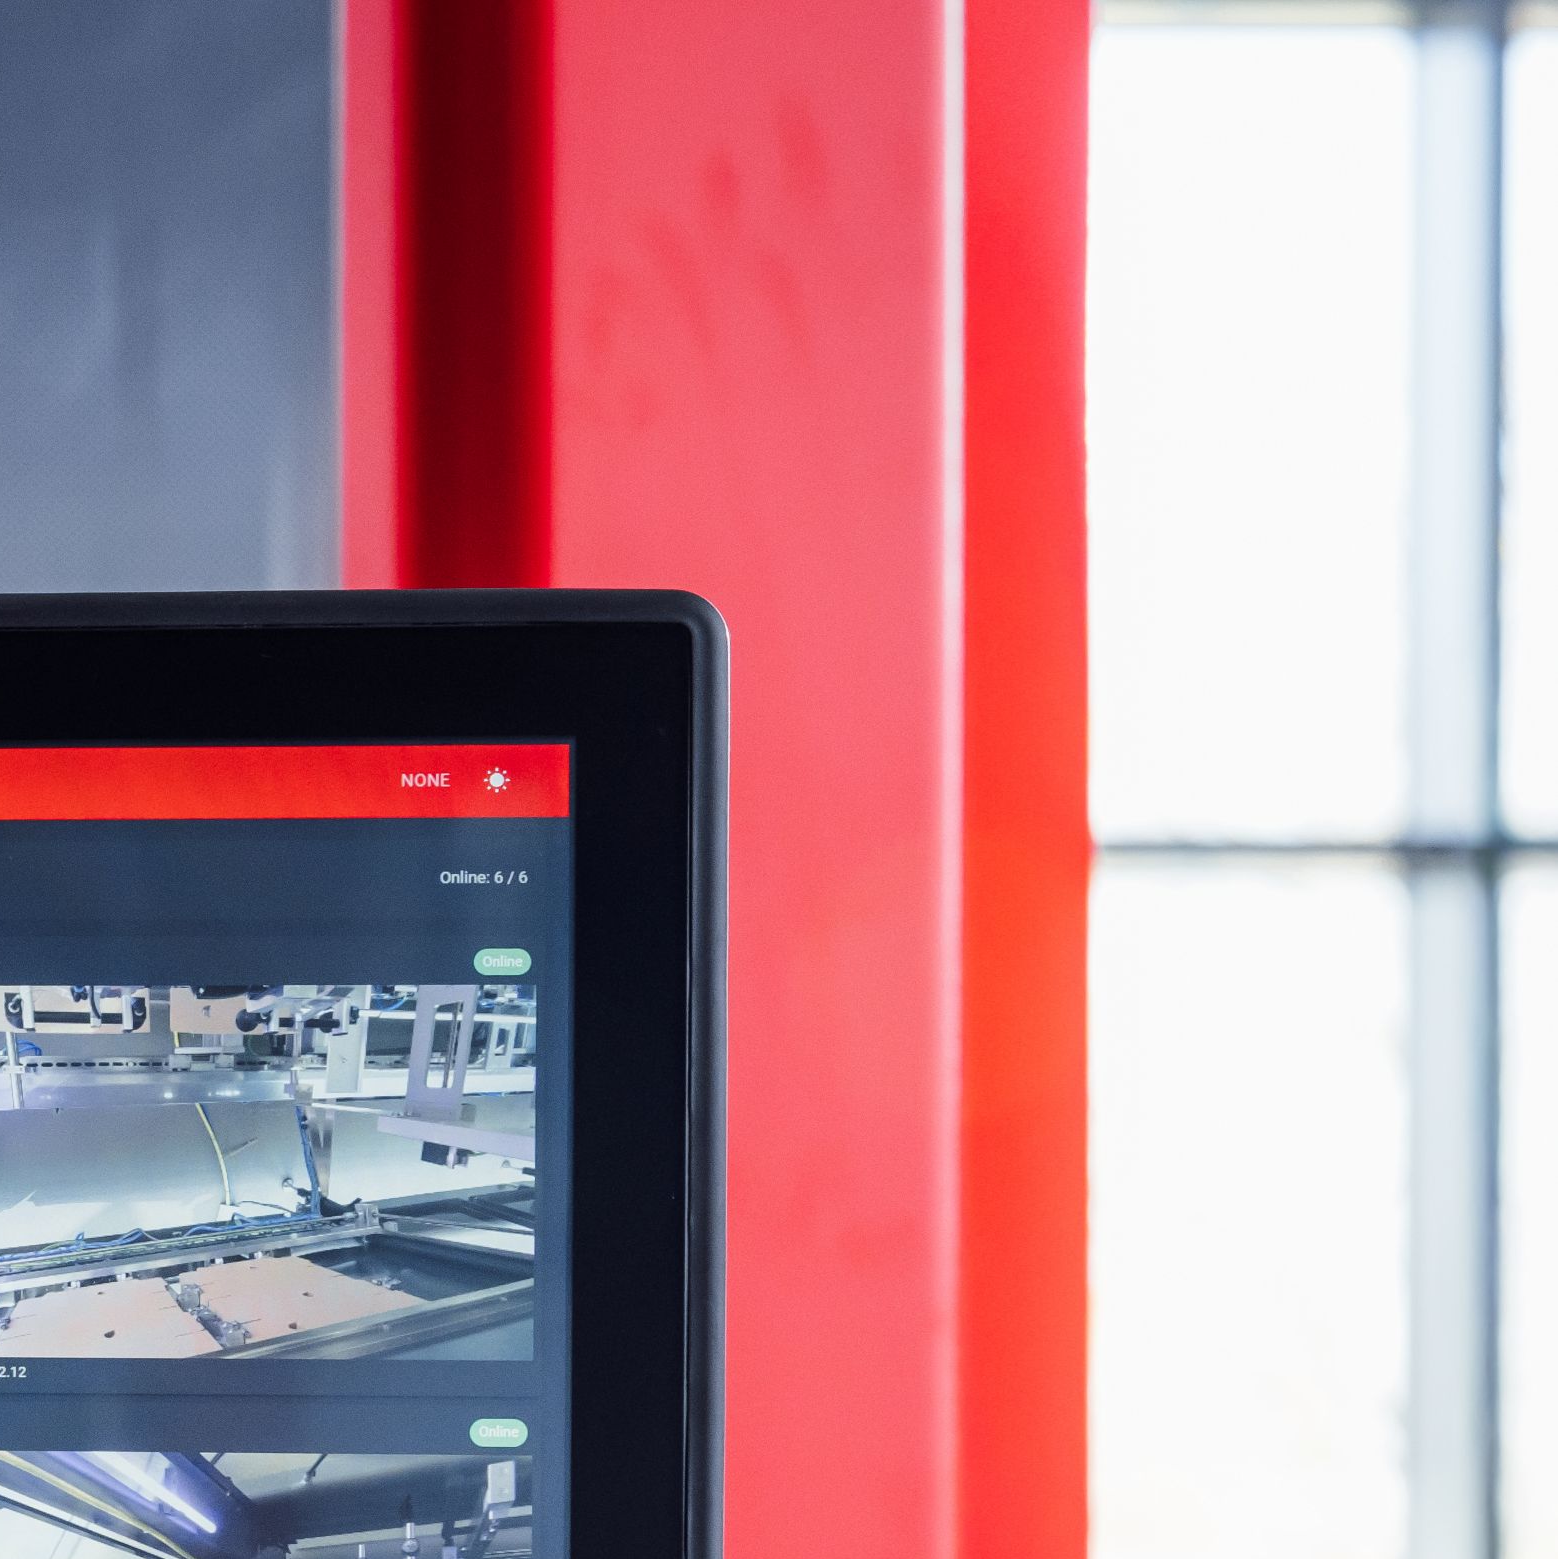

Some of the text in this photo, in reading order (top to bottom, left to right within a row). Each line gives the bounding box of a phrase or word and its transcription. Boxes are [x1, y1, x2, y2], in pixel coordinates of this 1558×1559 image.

[401, 773, 451, 788] NONE
[440, 870, 528, 885] Online: 6 / 6
[483, 955, 523, 968] Online
[479, 1425, 520, 1438] Online
